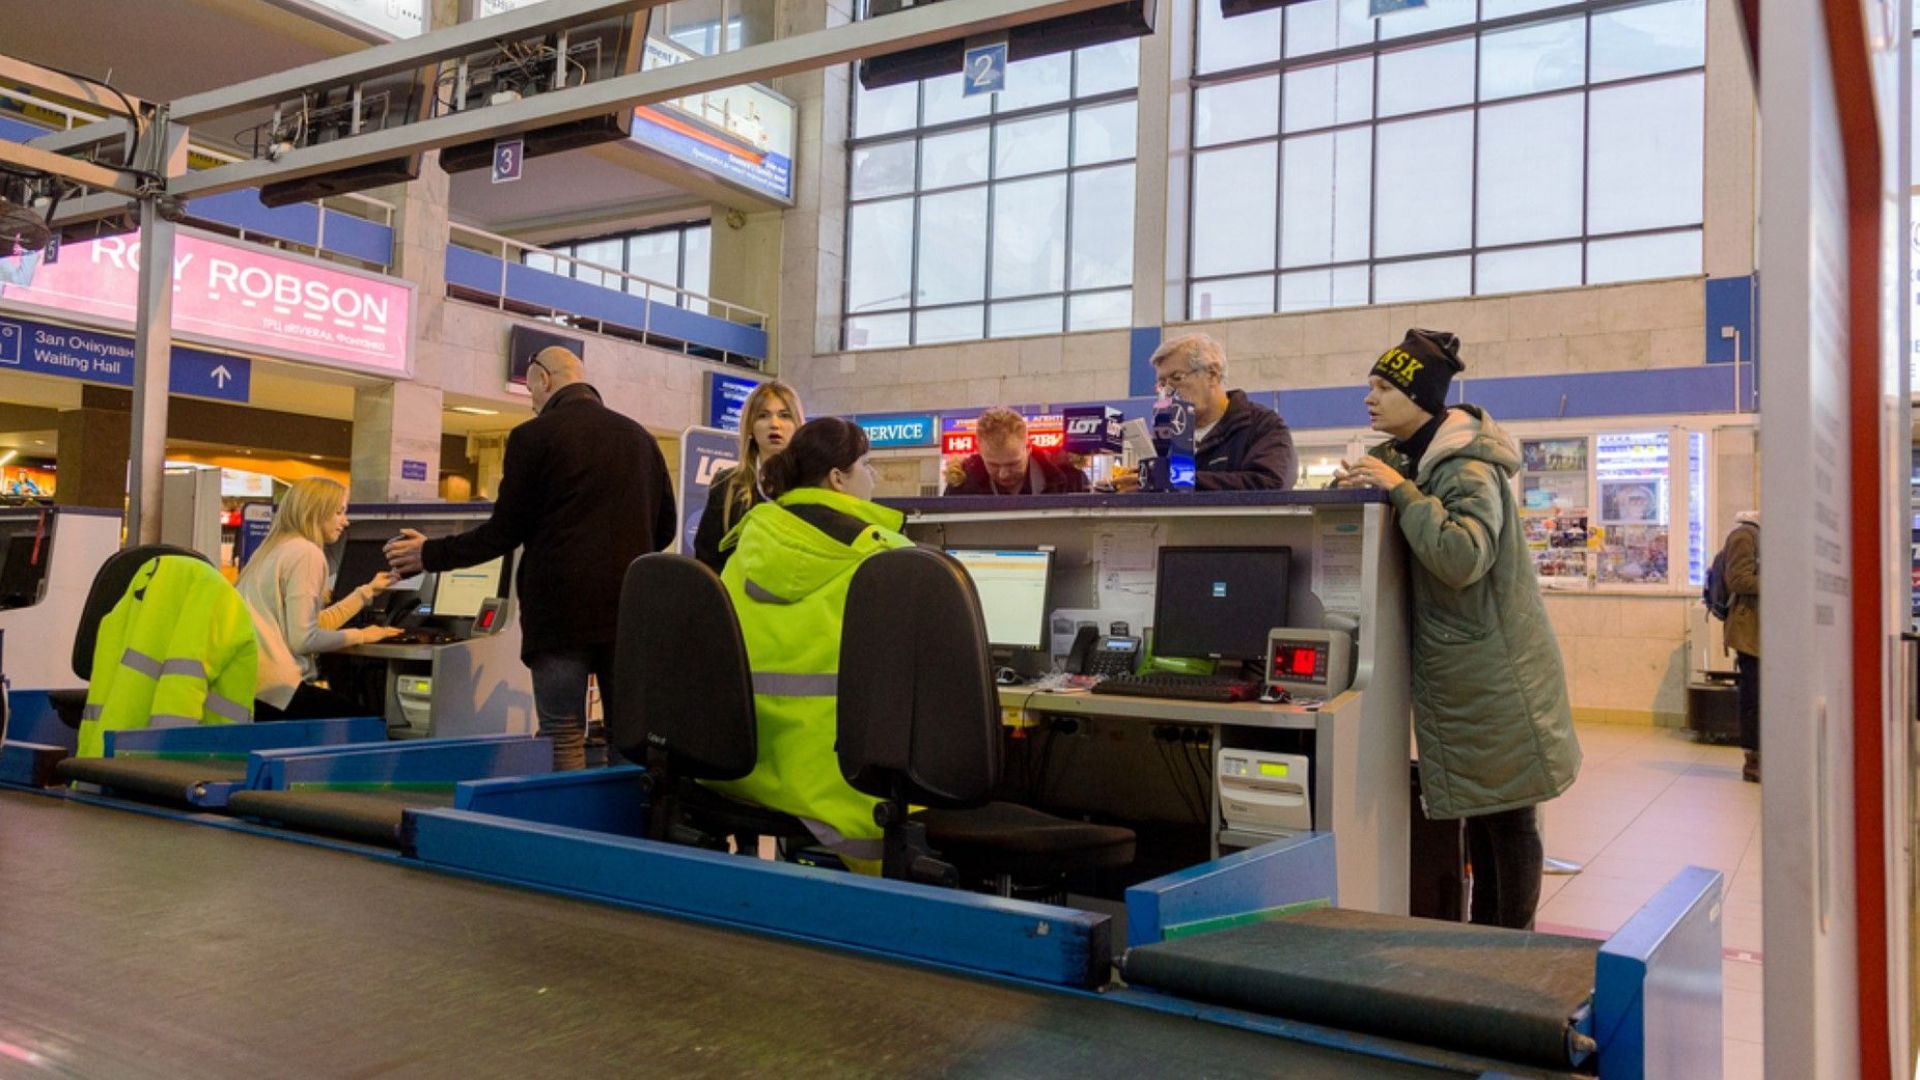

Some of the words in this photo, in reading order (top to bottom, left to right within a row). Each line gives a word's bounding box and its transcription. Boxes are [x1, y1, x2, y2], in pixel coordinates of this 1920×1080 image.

[973, 54, 993, 87] 2
[499, 148, 512, 174] 3
[207, 257, 389, 325] ROBSON
[34, 329, 65, 347] Зал
[34, 348, 88, 373] Waiting
[93, 357, 121, 374] Hall
[1066, 419, 1103, 434] LOT
